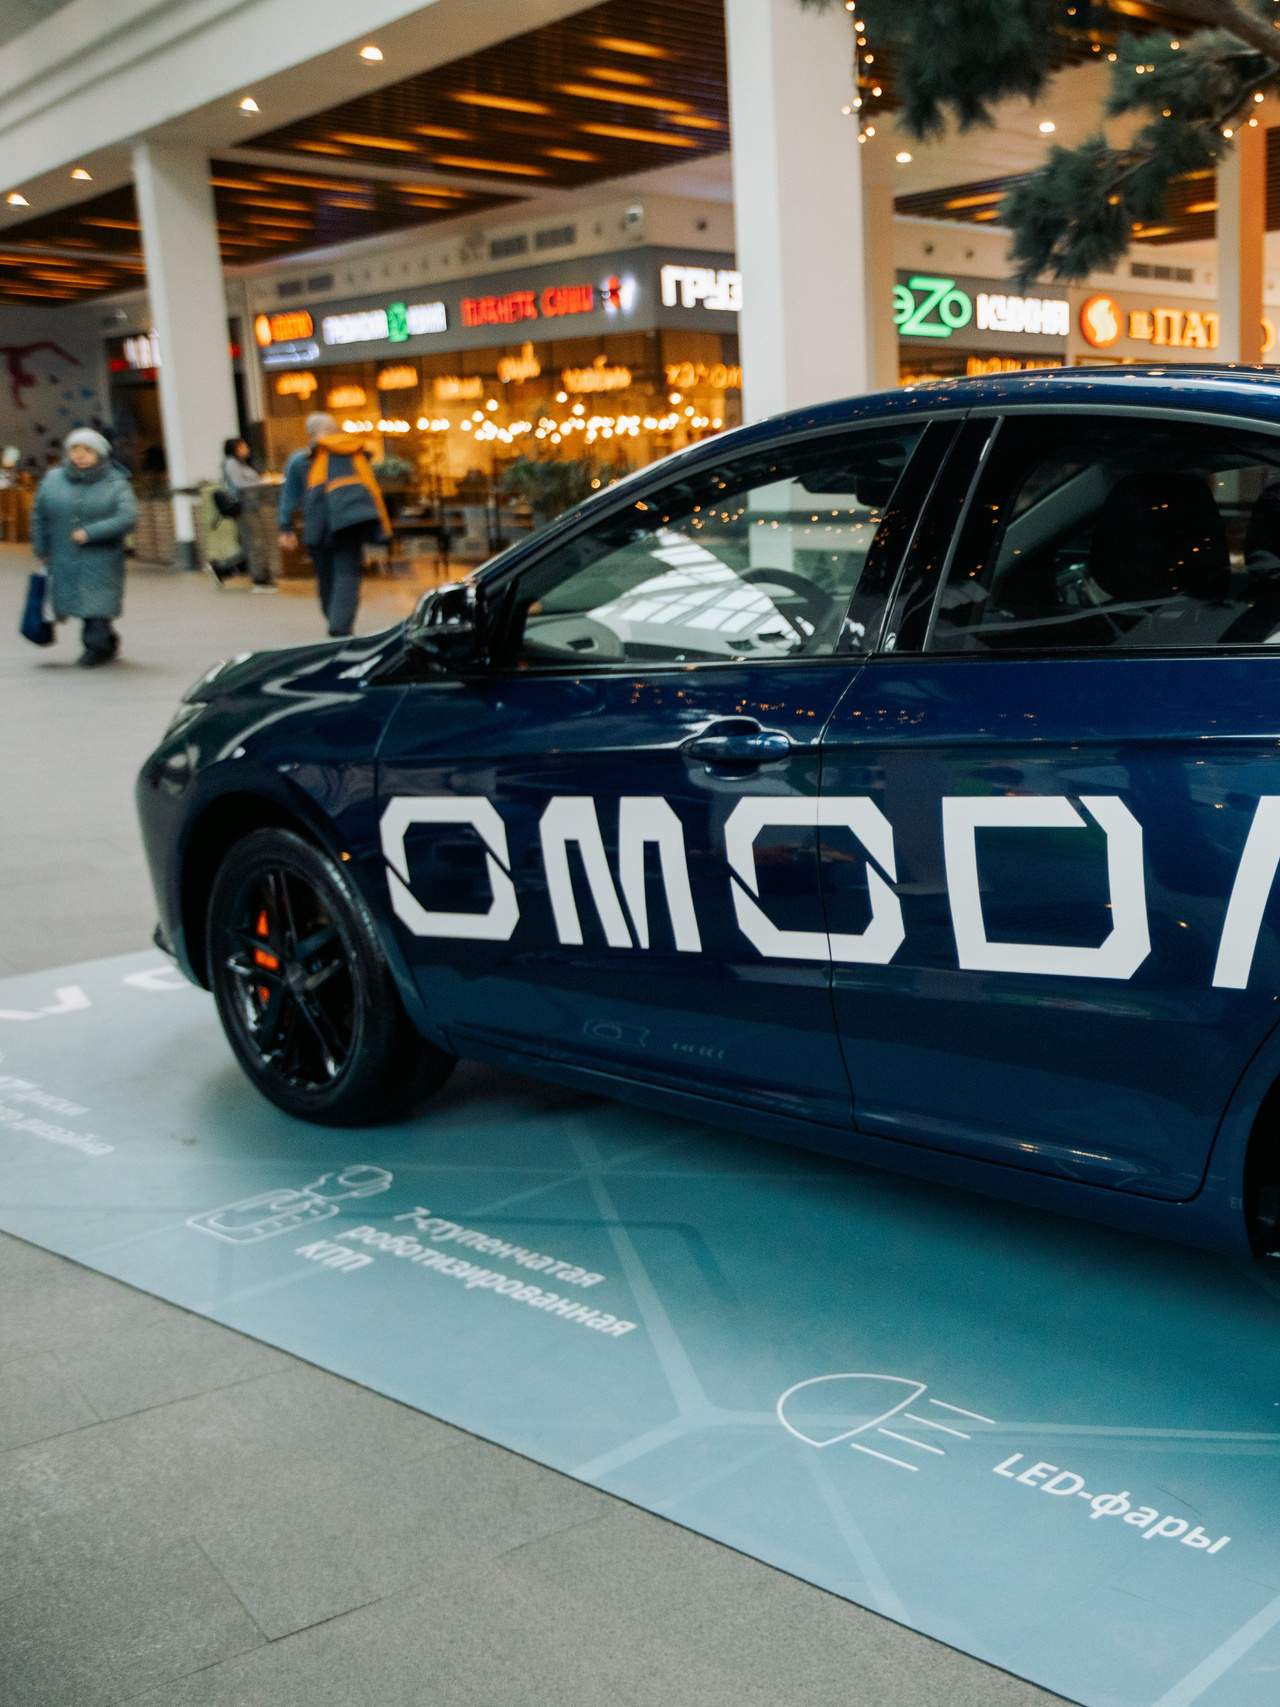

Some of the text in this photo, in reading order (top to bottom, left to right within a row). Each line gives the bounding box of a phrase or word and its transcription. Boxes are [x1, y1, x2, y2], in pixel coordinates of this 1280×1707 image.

[976, 293, 1070, 336] КУХНЯ
[295, 1239, 375, 1273] КПП
[335, 1225, 638, 1337] роботизированная
[394, 1206, 606, 1288] 7-ступенчатая
[992, 1452, 1232, 1554] LED-фары
